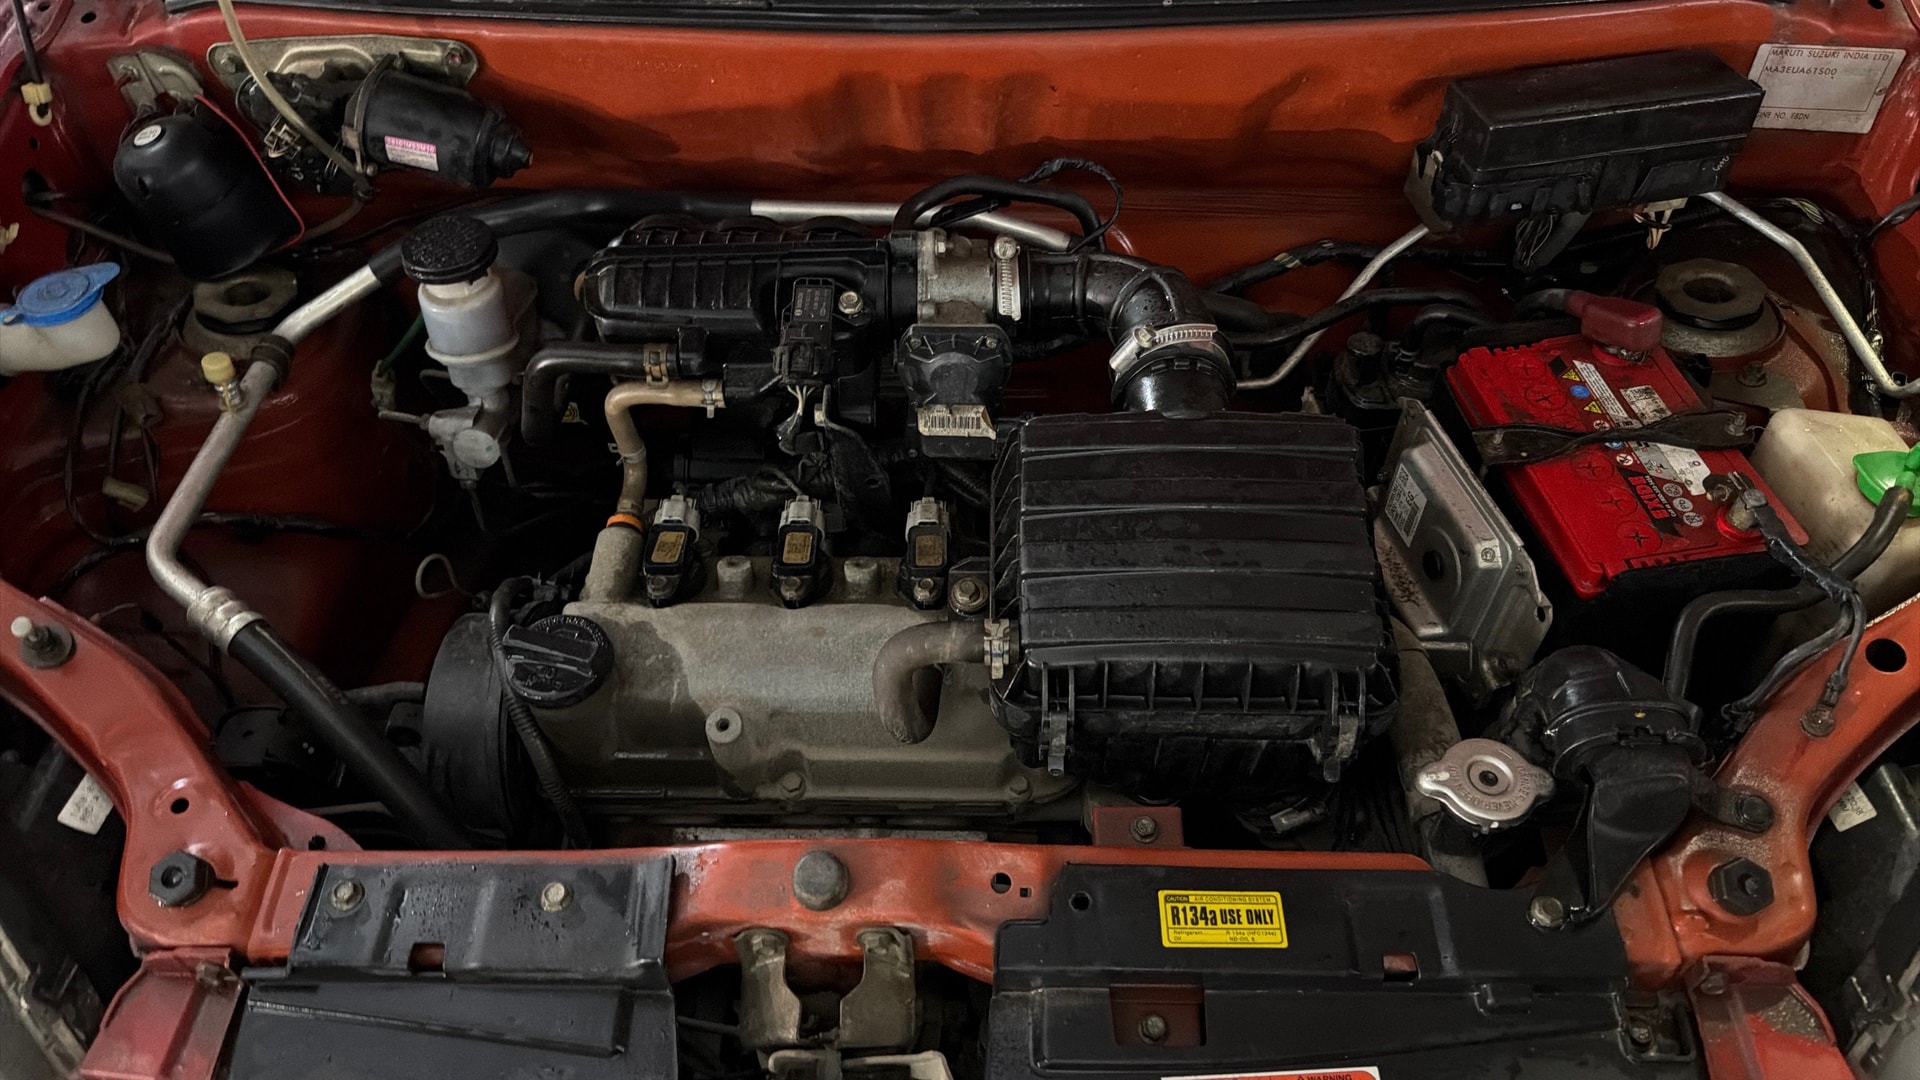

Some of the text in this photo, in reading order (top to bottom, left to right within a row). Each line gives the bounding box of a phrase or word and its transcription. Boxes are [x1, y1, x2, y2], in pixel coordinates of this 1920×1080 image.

[1770, 49, 1890, 61] MARUTI SUZUKI INDIA LTD
[1628, 476, 1670, 519] EXIDE
[1170, 905, 1274, 927] R134a USE ONLY
